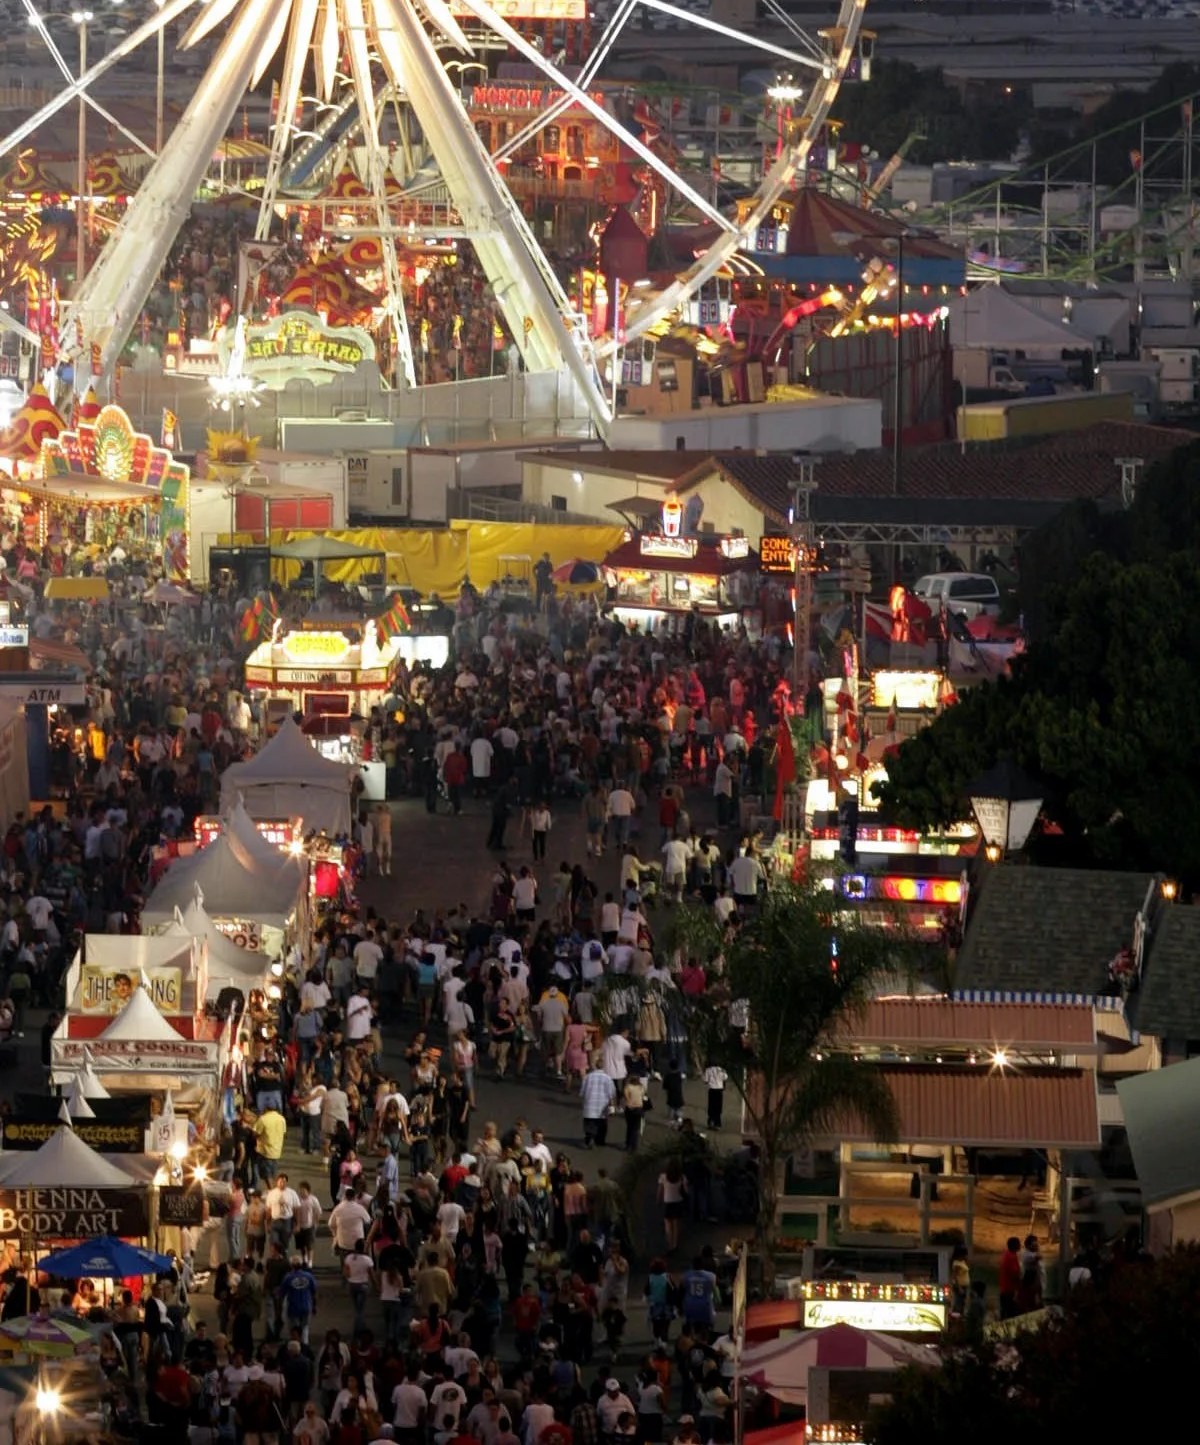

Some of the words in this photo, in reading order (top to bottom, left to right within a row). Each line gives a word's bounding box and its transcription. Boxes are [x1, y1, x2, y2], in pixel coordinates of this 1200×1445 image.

[473, 86, 541, 107] MOSCOW
[347, 458, 368, 471] CAT
[291, 670, 317, 682] COTTON
[28, 689, 61, 702] ATM
[87, 976, 112, 1002] THE
[64, 1042, 129, 1055] PLANET
[133, 1041, 208, 1055] COOKIES
[16, 1189, 106, 1211] HENNA
[74, 1208, 123, 1233] ART
[690, 1283, 704, 1296] 15
